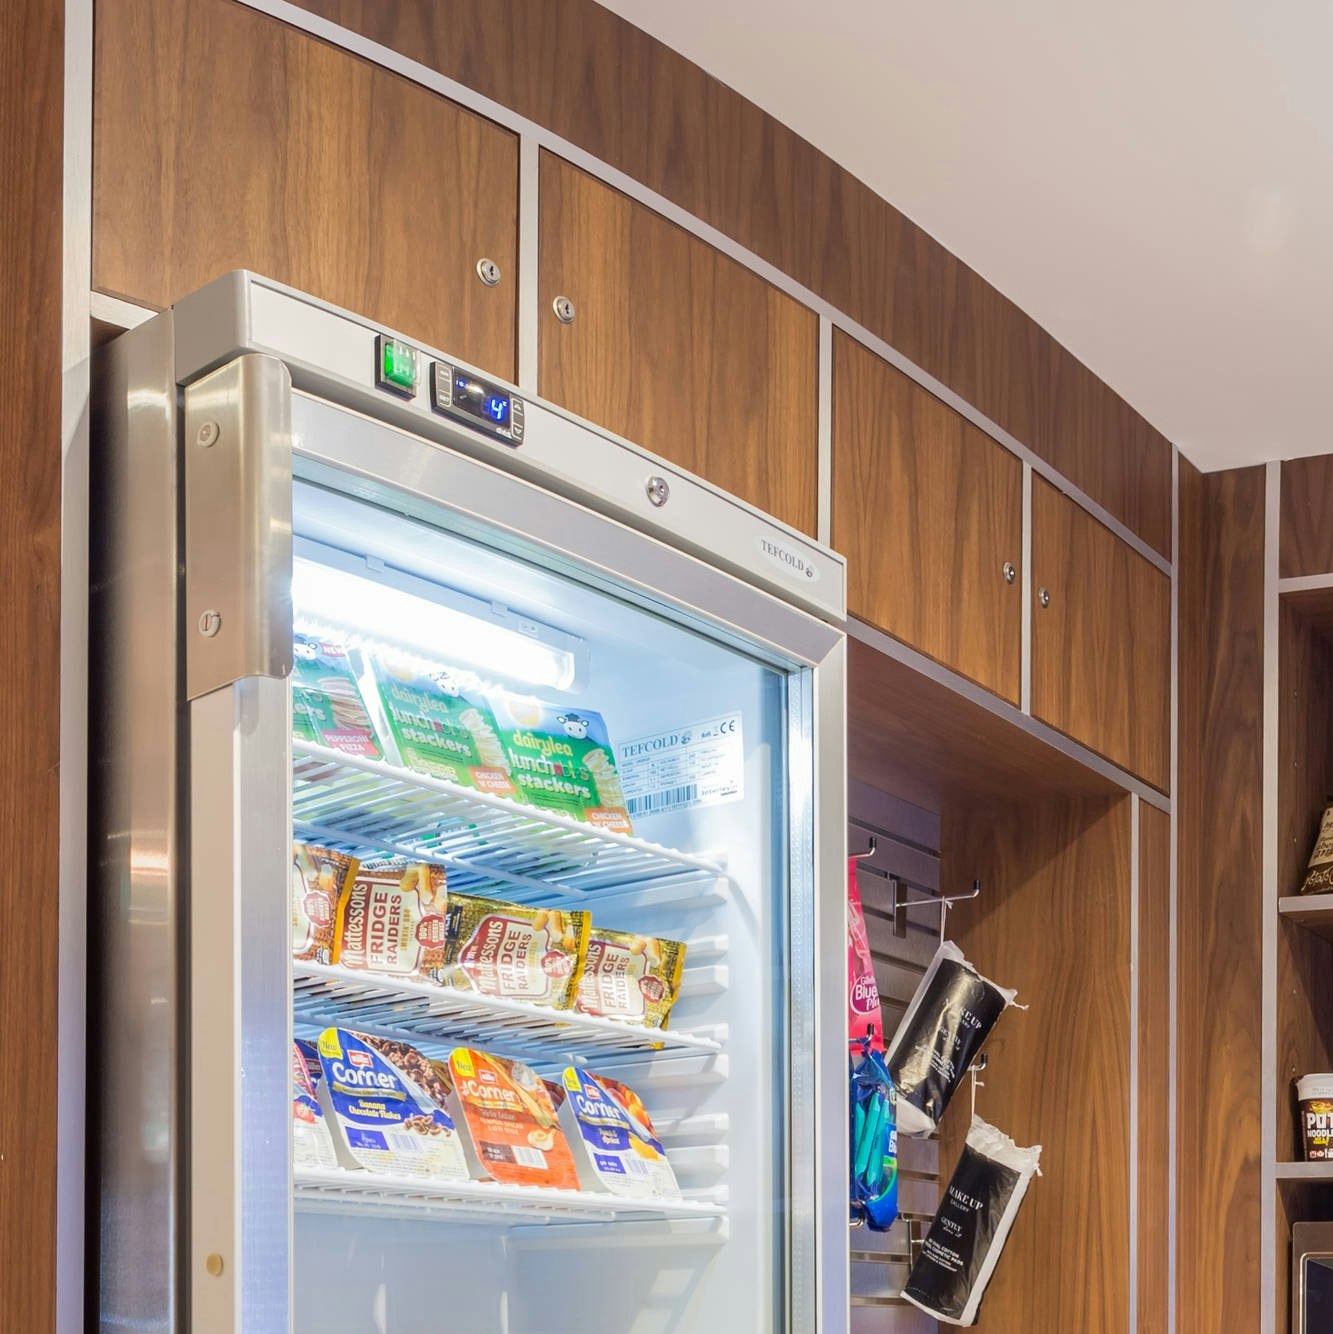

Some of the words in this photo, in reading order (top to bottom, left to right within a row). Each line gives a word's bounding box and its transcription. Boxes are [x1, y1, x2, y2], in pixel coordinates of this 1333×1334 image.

[761, 540, 804, 570] TEFCOLD
[513, 730, 573, 757] dairylea
[622, 735, 679, 758] TEFCOLD
[518, 770, 592, 800] stackers
[345, 883, 368, 970] Mattessons
[369, 892, 388, 965] FRIDGE
[385, 894, 402, 965] RAIDERS
[501, 930, 521, 990] FRIDGE
[513, 933, 533, 990] RAIDERS
[600, 953, 619, 1008] FRIDGE
[616, 957, 630, 1009] RAIDERS
[331, 1062, 397, 1088] Corner
[469, 1081, 515, 1103] Corner
[576, 1095, 622, 1120] Corner
[949, 1185, 969, 1204] MAKE
[970, 1198, 983, 1210] UP
